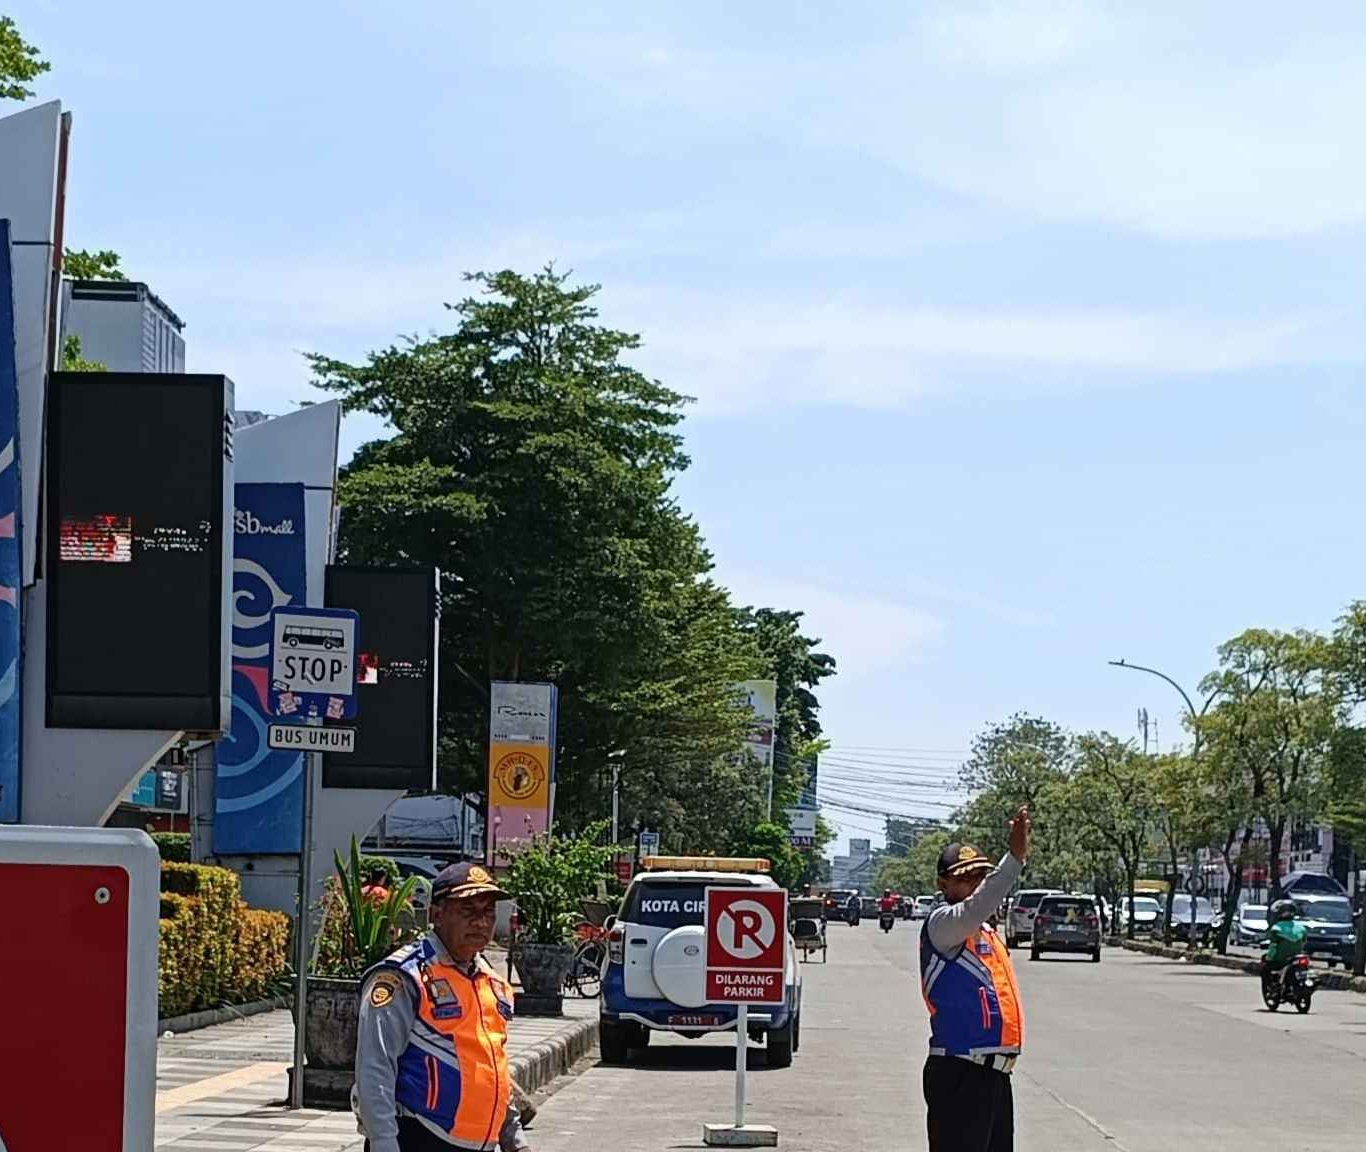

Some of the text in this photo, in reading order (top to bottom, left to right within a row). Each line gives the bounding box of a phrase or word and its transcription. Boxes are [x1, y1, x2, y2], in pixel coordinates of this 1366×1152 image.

[235, 511, 295, 534] sbmall
[284, 656, 343, 682] STOP
[275, 728, 351, 747] BUS UMUM
[641, 900, 680, 912] KOTA
[715, 974, 773, 985] DILARANG
[723, 986, 764, 997] PARKIR
